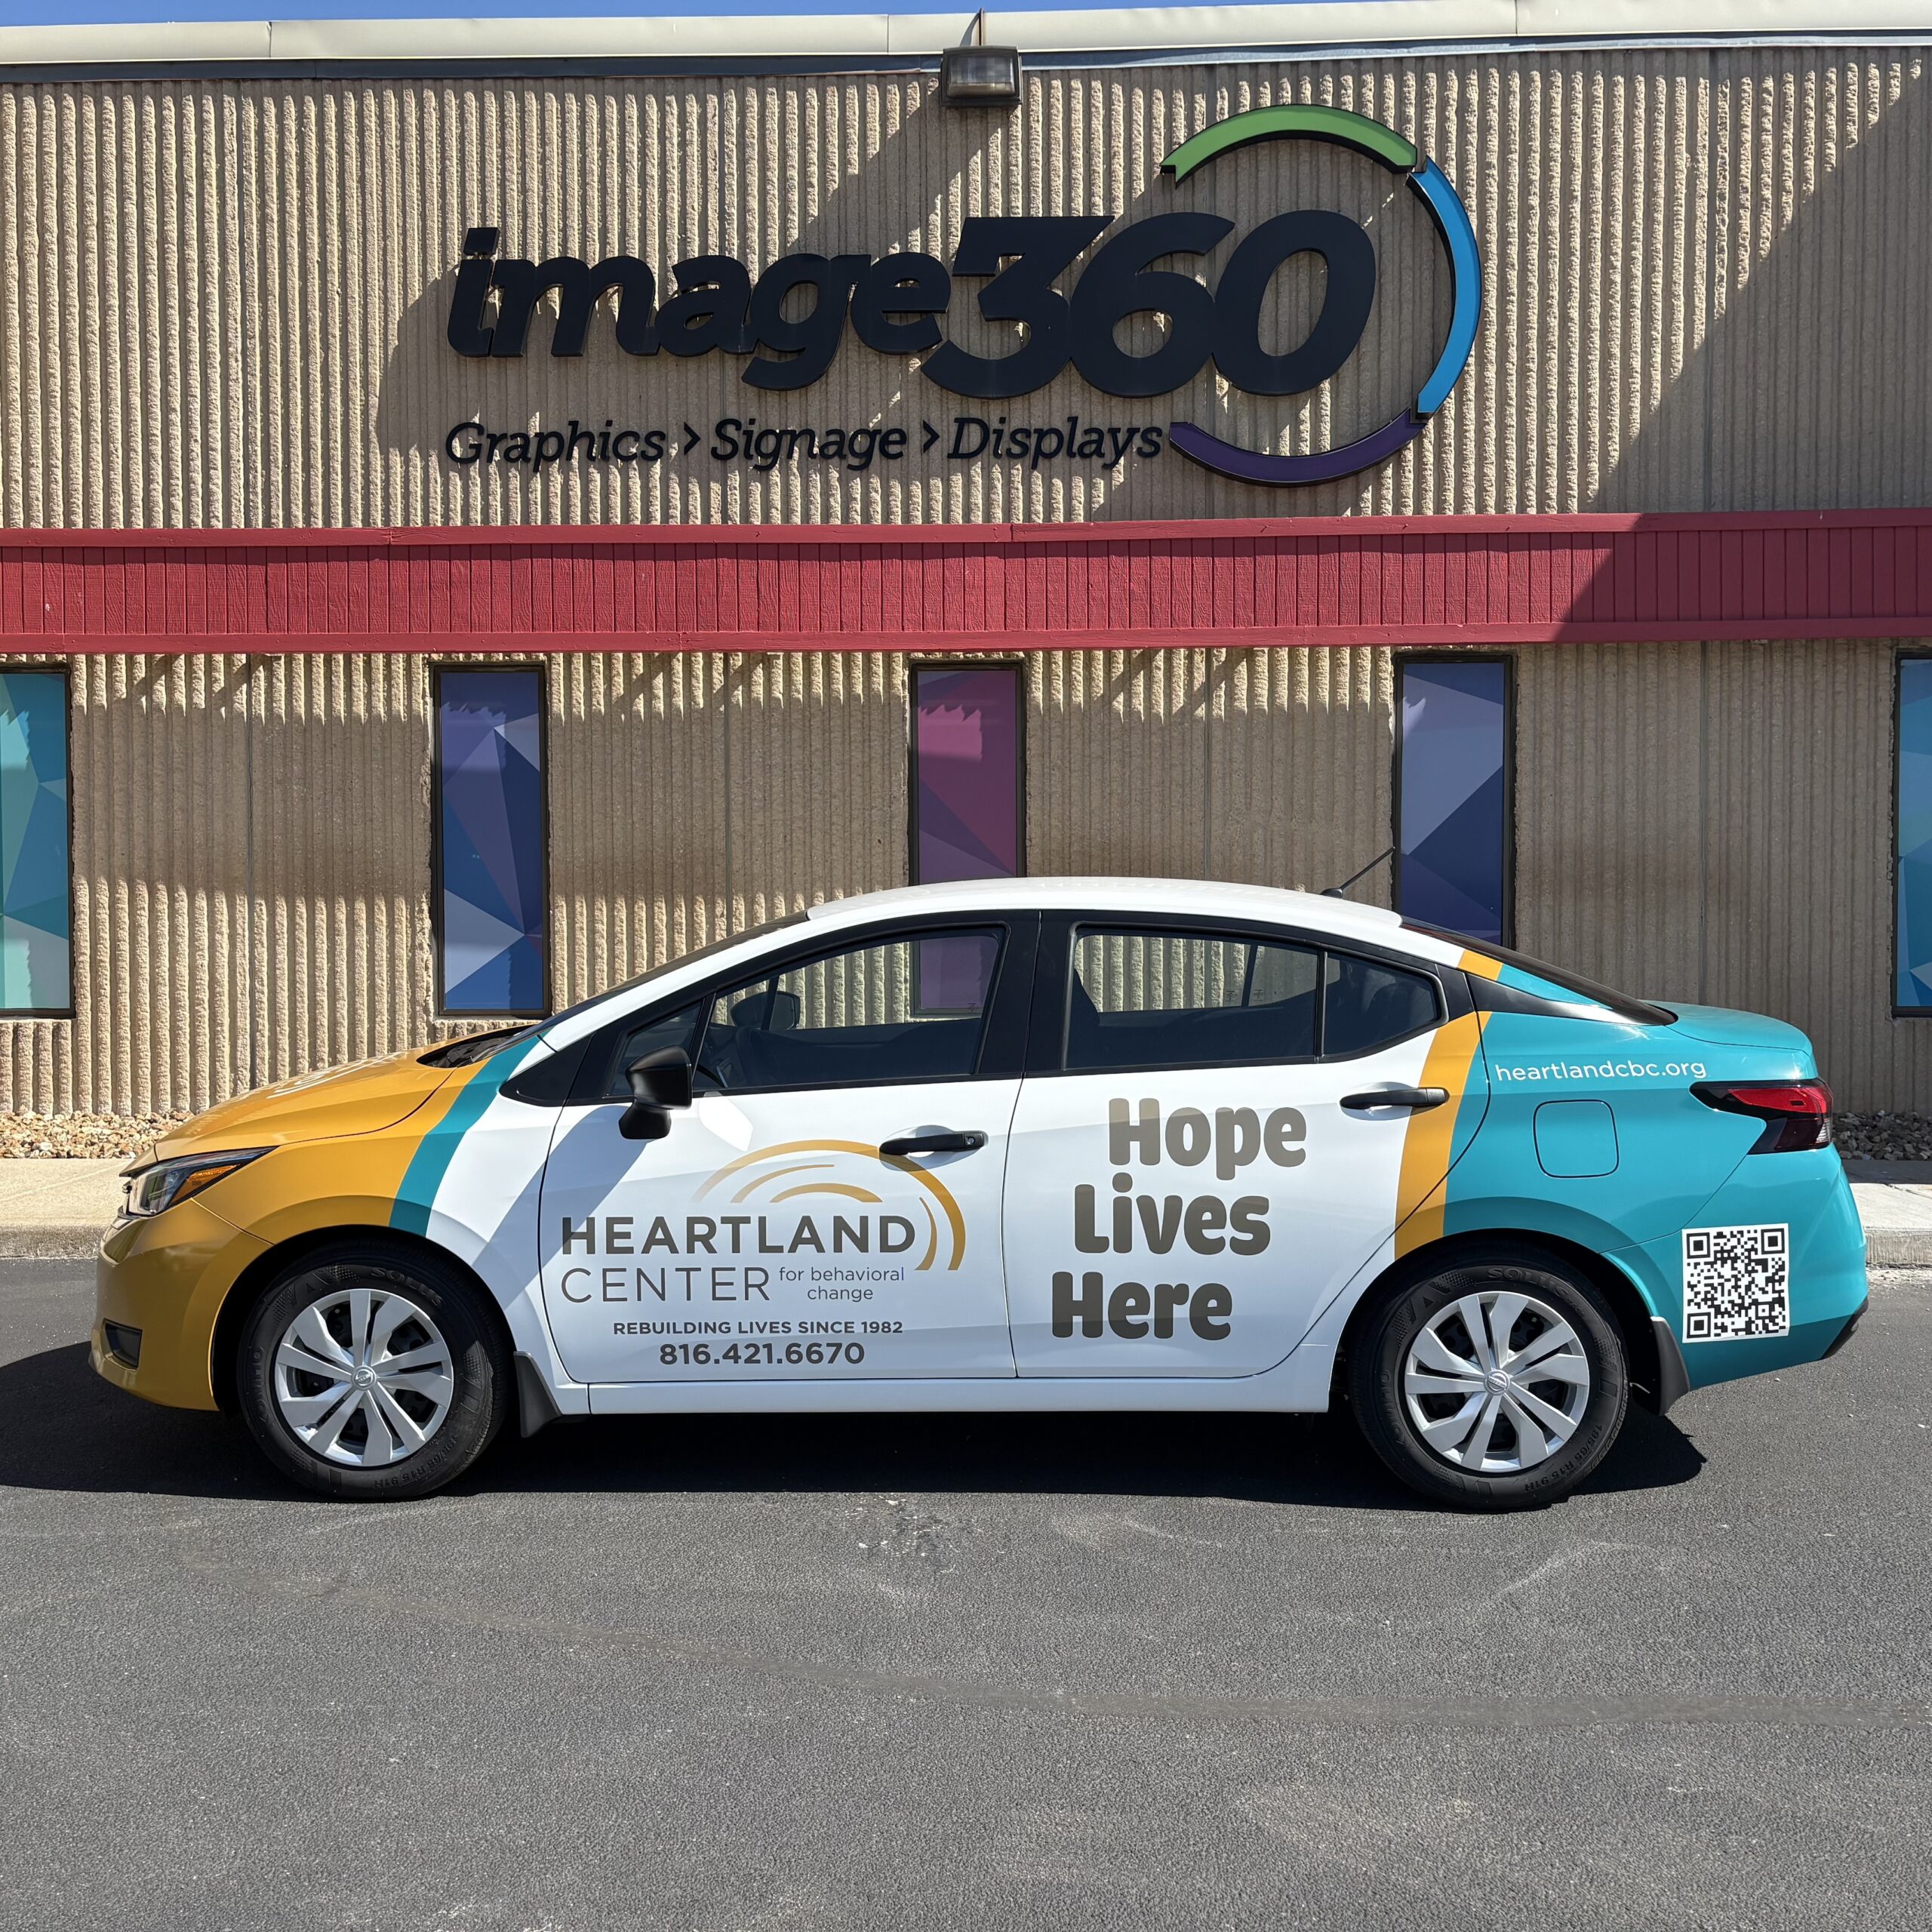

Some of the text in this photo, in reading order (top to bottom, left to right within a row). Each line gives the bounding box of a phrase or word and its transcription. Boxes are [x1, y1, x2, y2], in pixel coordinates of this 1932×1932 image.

[447, 209, 1376, 400] image360
[445, 416, 1163, 473] Graphics Signage Displays
[1495, 1060, 1707, 1081] heartlandcbc.org
[1109, 1098, 1307, 1180] Hope
[1074, 1172, 1271, 1256] Lives
[561, 1215, 915, 1254] HEARTLAND
[561, 1266, 770, 1303] CENTER
[780, 1266, 905, 1281] for behavioral
[807, 1286, 874, 1303] change
[1052, 1271, 1232, 1340] Here
[614, 1320, 903, 1335] REBUILDING LIVES SINCE 1982
[659, 1342, 865, 1365] 816.421.6670
